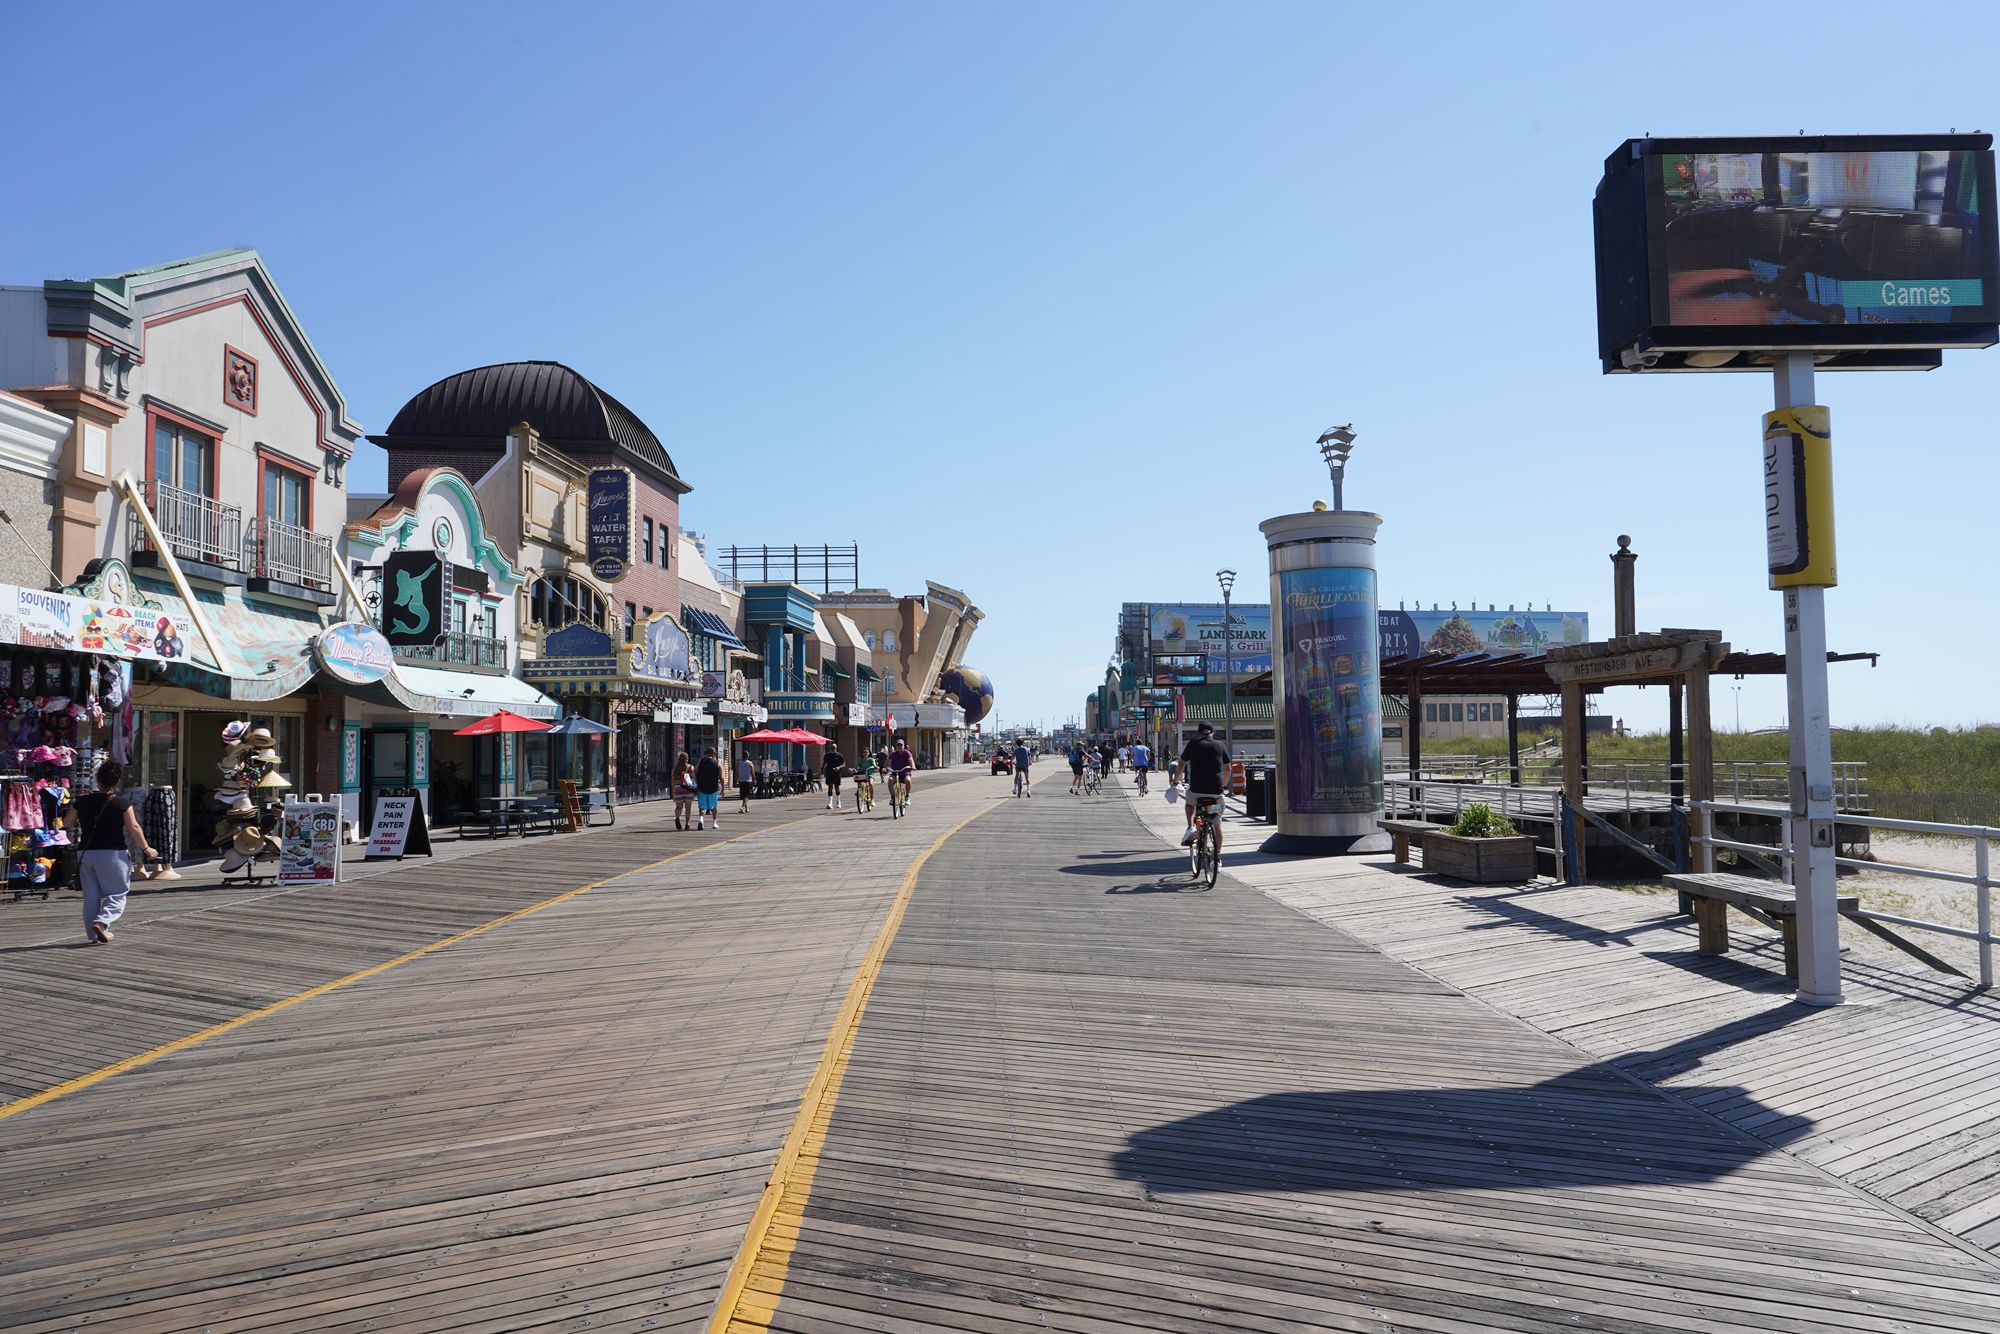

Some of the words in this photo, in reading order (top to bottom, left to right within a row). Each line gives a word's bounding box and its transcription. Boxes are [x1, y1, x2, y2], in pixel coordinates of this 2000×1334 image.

[1881, 281, 1951, 305] Games
[592, 523, 626, 532] WATER
[593, 535, 624, 544] TAFFY
[20, 591, 71, 628] SOUVENIRS
[134, 610, 156, 620] BEACH
[134, 619, 155, 629] ITEMS
[1390, 616, 1400, 626] AT
[176, 622, 189, 632] HATS
[1315, 634, 1347, 644] FANDUEL
[1202, 641, 1222, 650] Bar
[1237, 641, 1264, 650] Grill
[1574, 658, 1627, 675] WESTMINSTER
[1635, 655, 1653, 667] AVE
[768, 700, 807, 710] ATLANTIC
[384, 801, 407, 809] NECK
[384, 811, 403, 819] PAIN
[313, 819, 336, 832] CBD
[377, 821, 405, 829] ENTER
